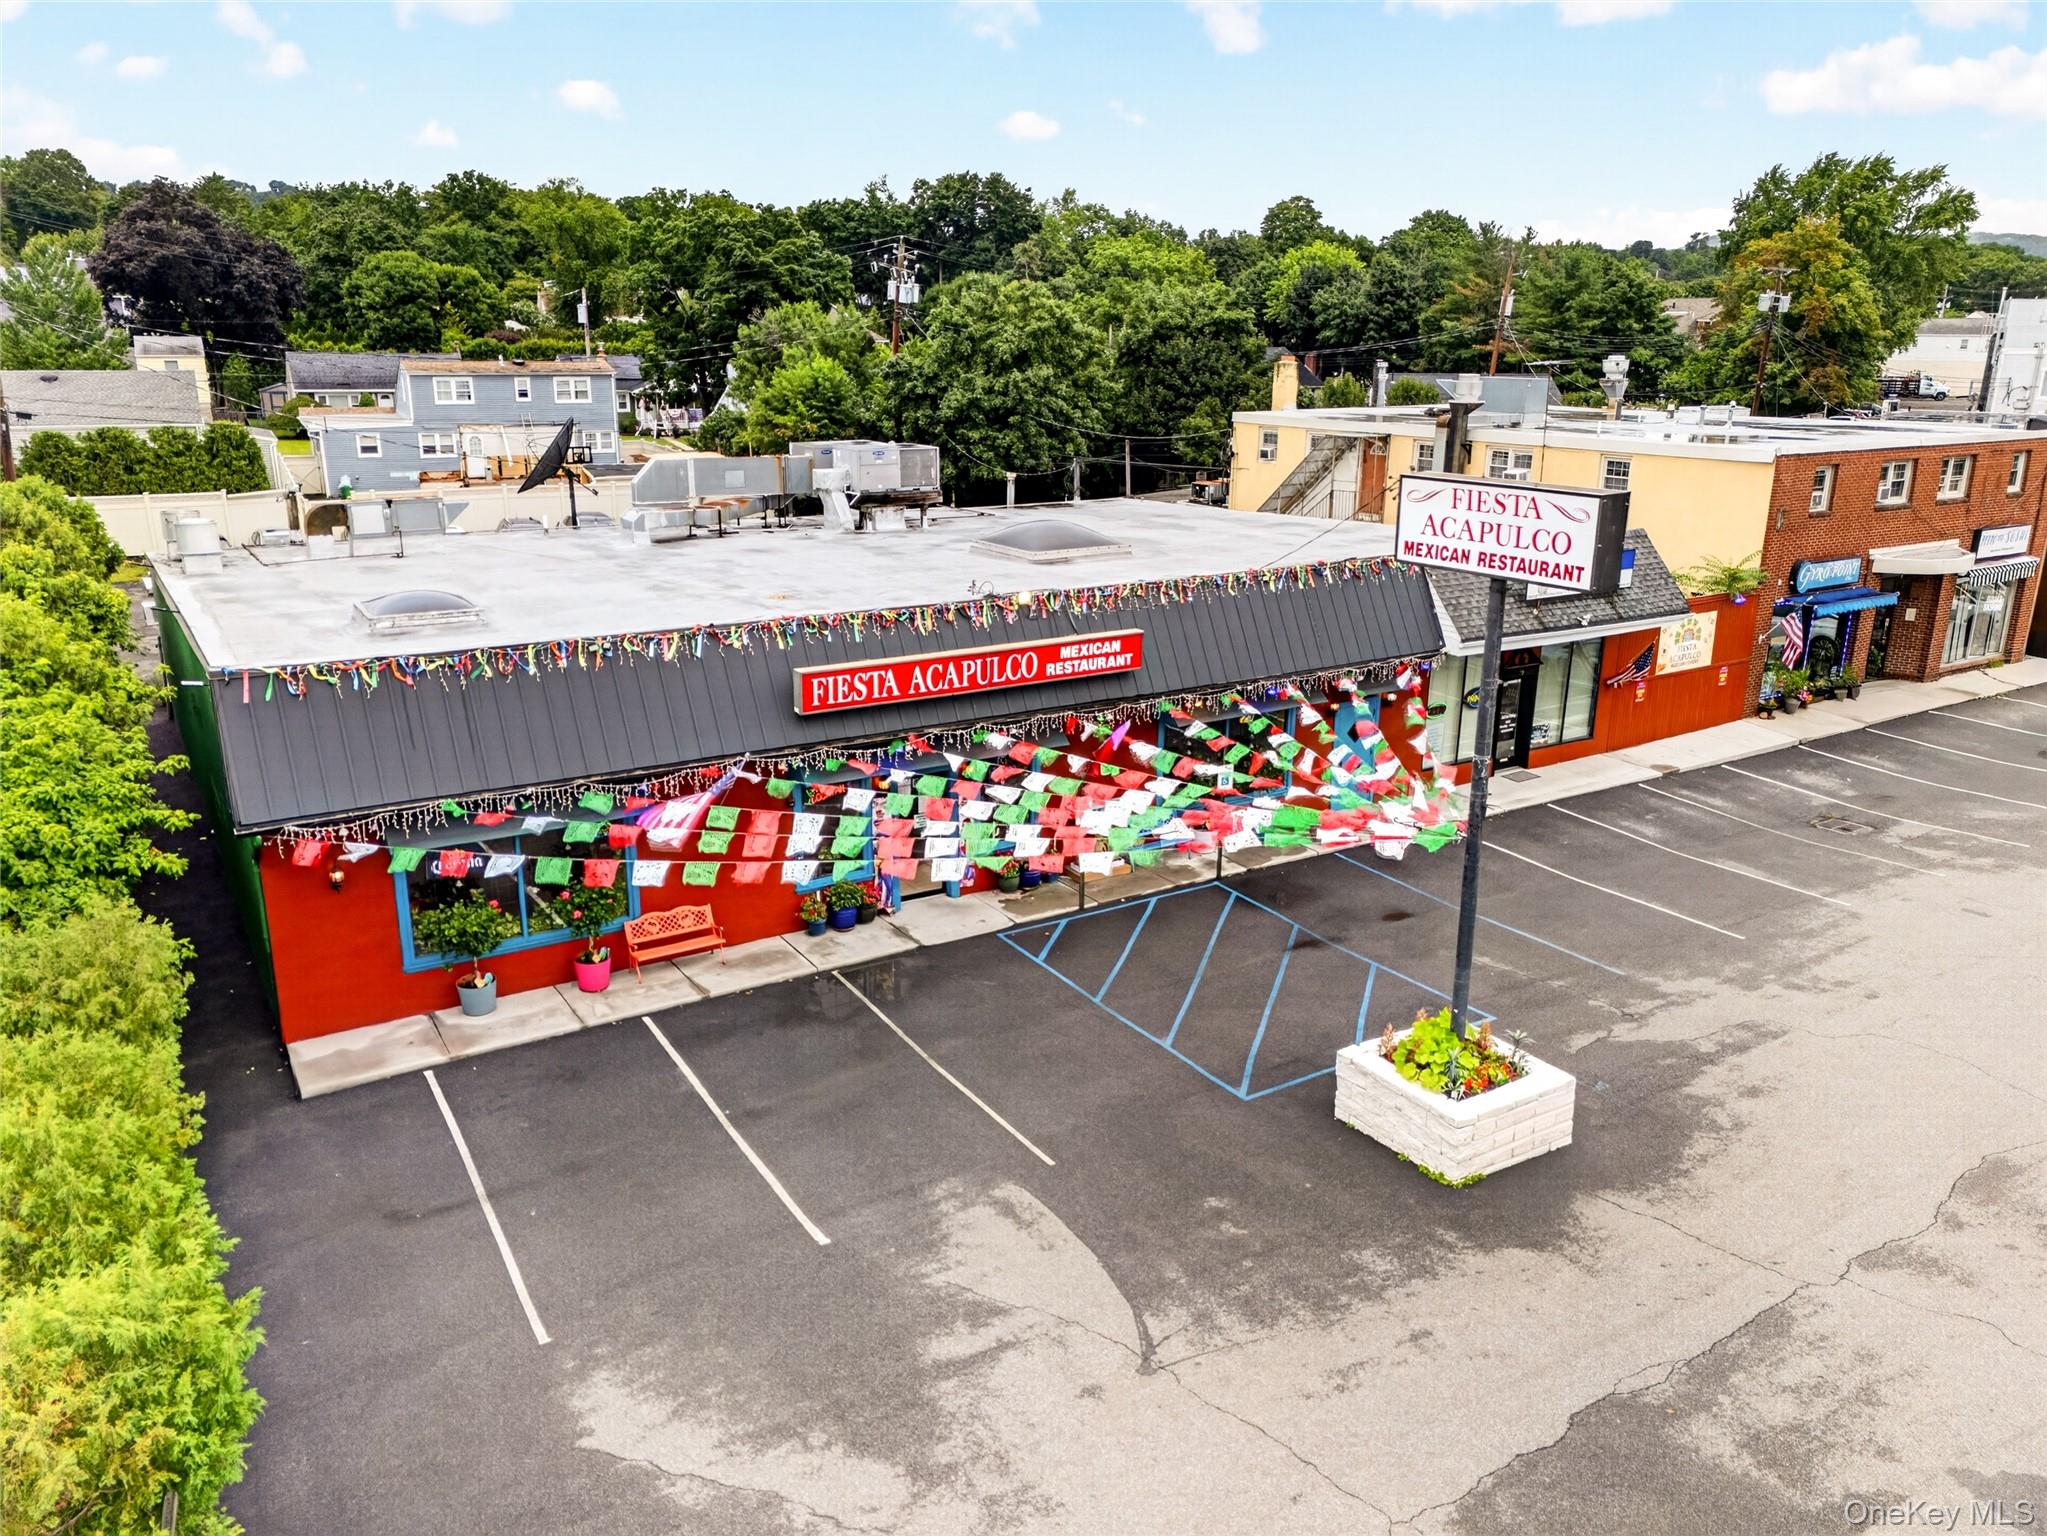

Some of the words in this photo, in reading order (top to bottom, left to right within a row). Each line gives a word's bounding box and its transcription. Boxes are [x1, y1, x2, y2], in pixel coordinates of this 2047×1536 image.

[1451, 488, 1543, 520] FIESTA
[1420, 514, 1572, 555] ACAPULCO
[1403, 540, 1471, 565] MEXICAN
[1476, 551, 1585, 583] RESTAURANT
[1799, 564, 1830, 590] GYRO
[1831, 563, 1858, 579] POINT
[1045, 653, 1134, 677] RESTAURANT
[1060, 640, 1121, 659] MEXICAN
[811, 670, 900, 706] FIESTA
[908, 651, 1039, 694] ACAPULCO
